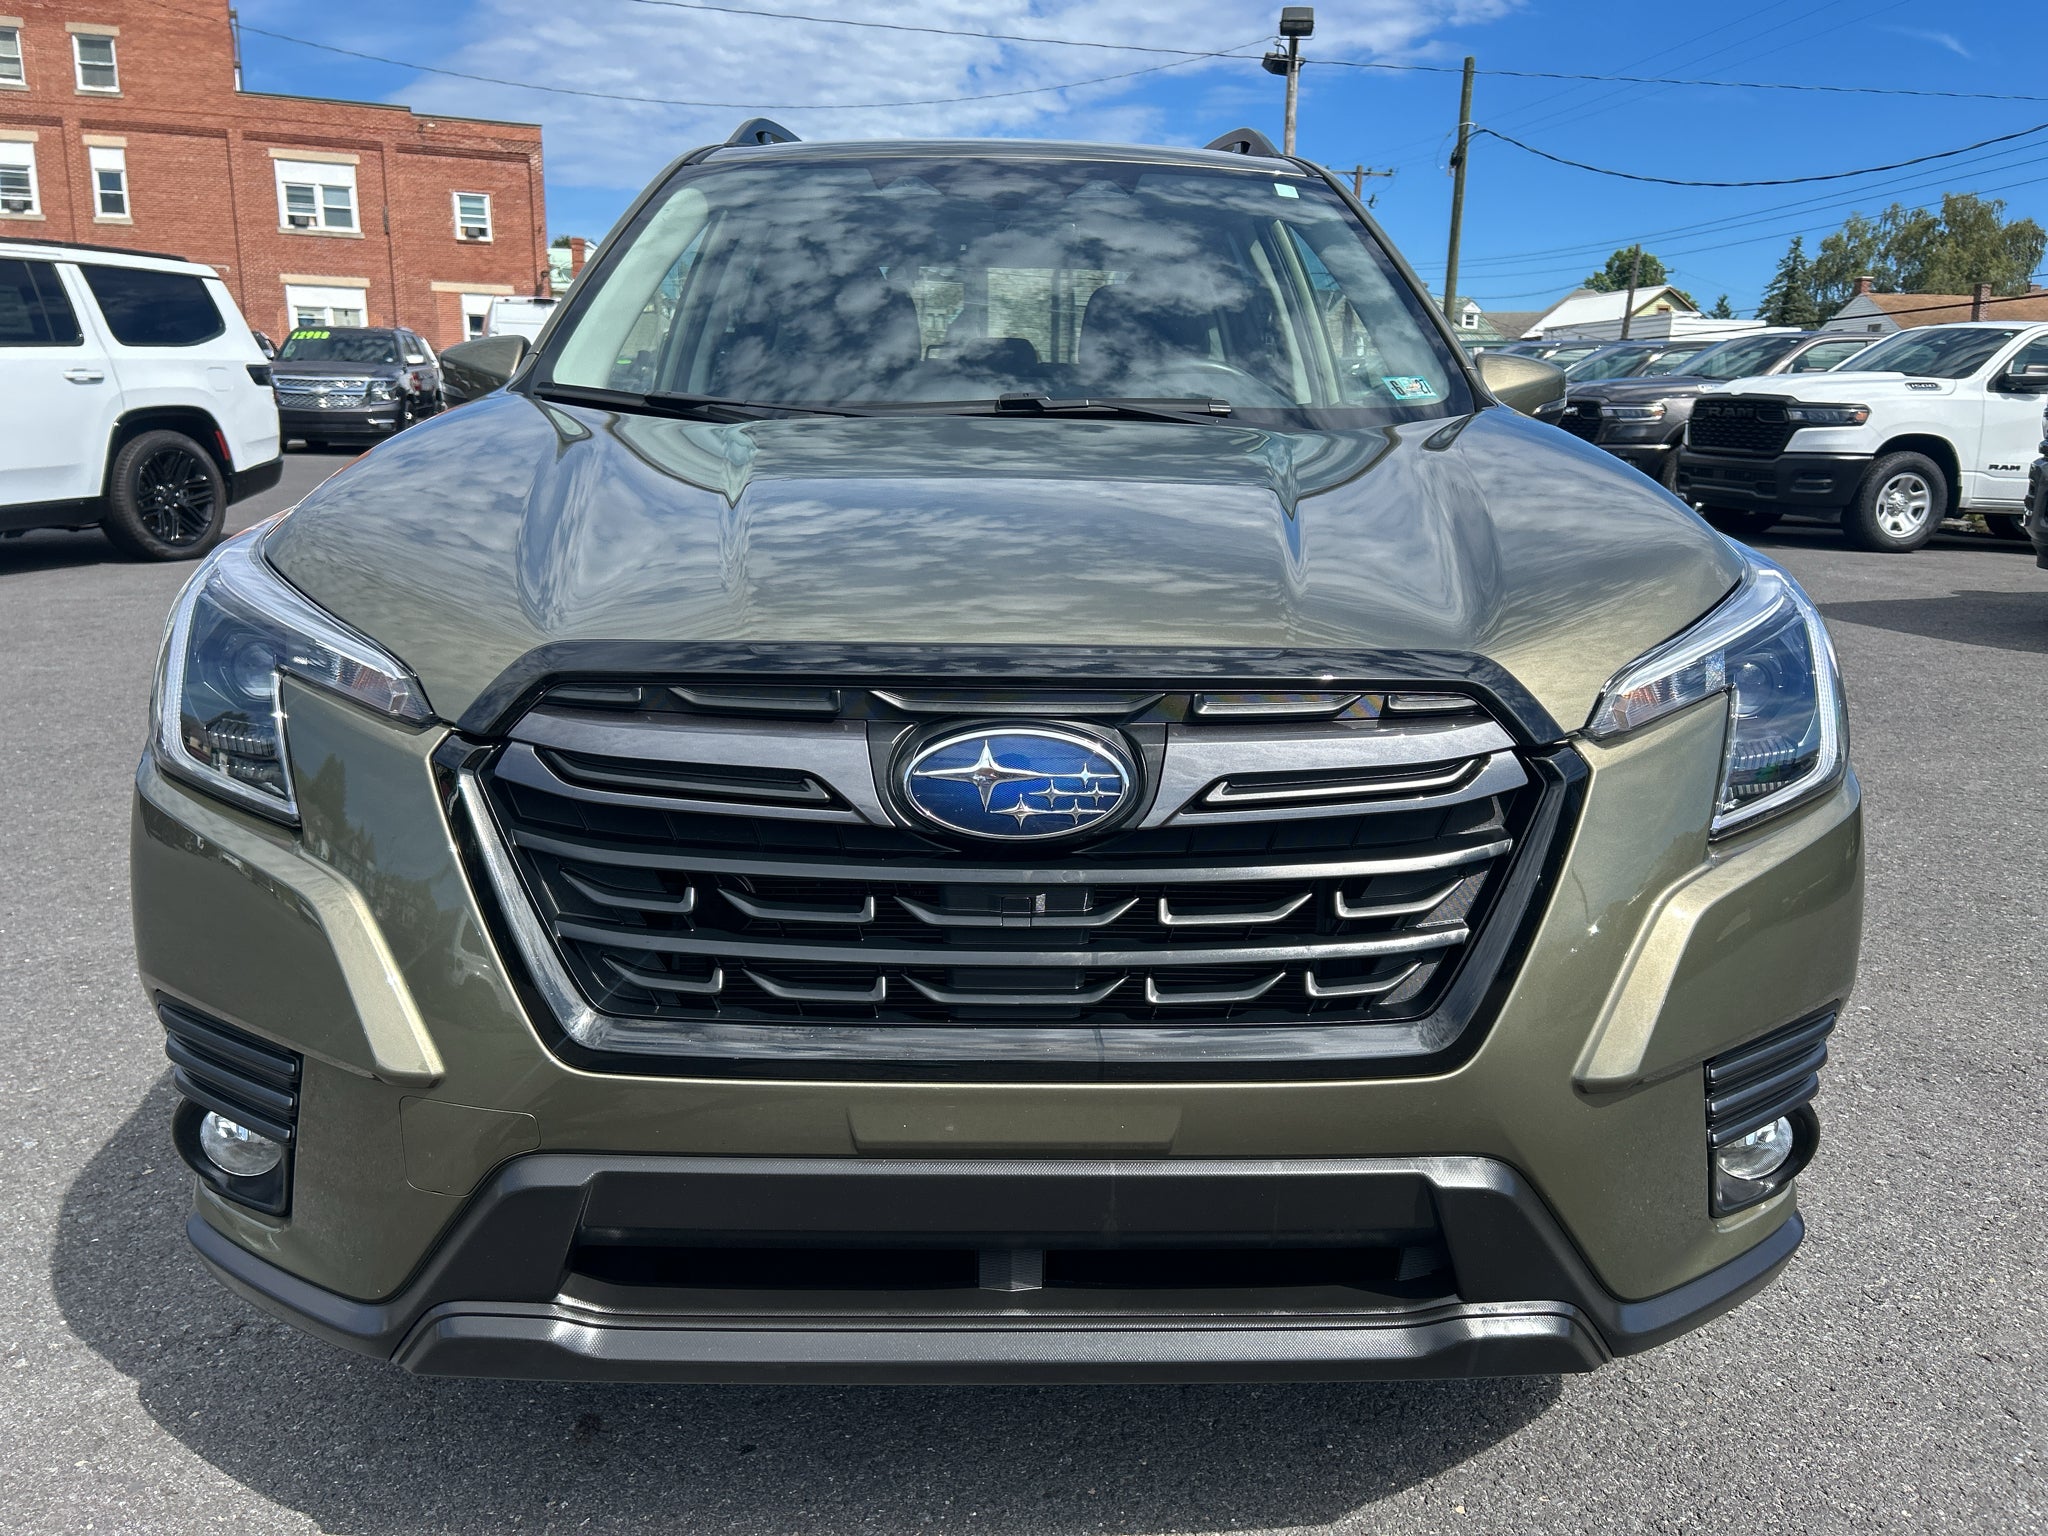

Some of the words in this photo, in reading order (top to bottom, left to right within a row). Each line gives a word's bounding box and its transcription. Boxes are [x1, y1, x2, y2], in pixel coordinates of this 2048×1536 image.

[1390, 380, 1406, 396] 6
[1708, 407, 1755, 418] RAM
[1988, 464, 2022, 472] RAM
